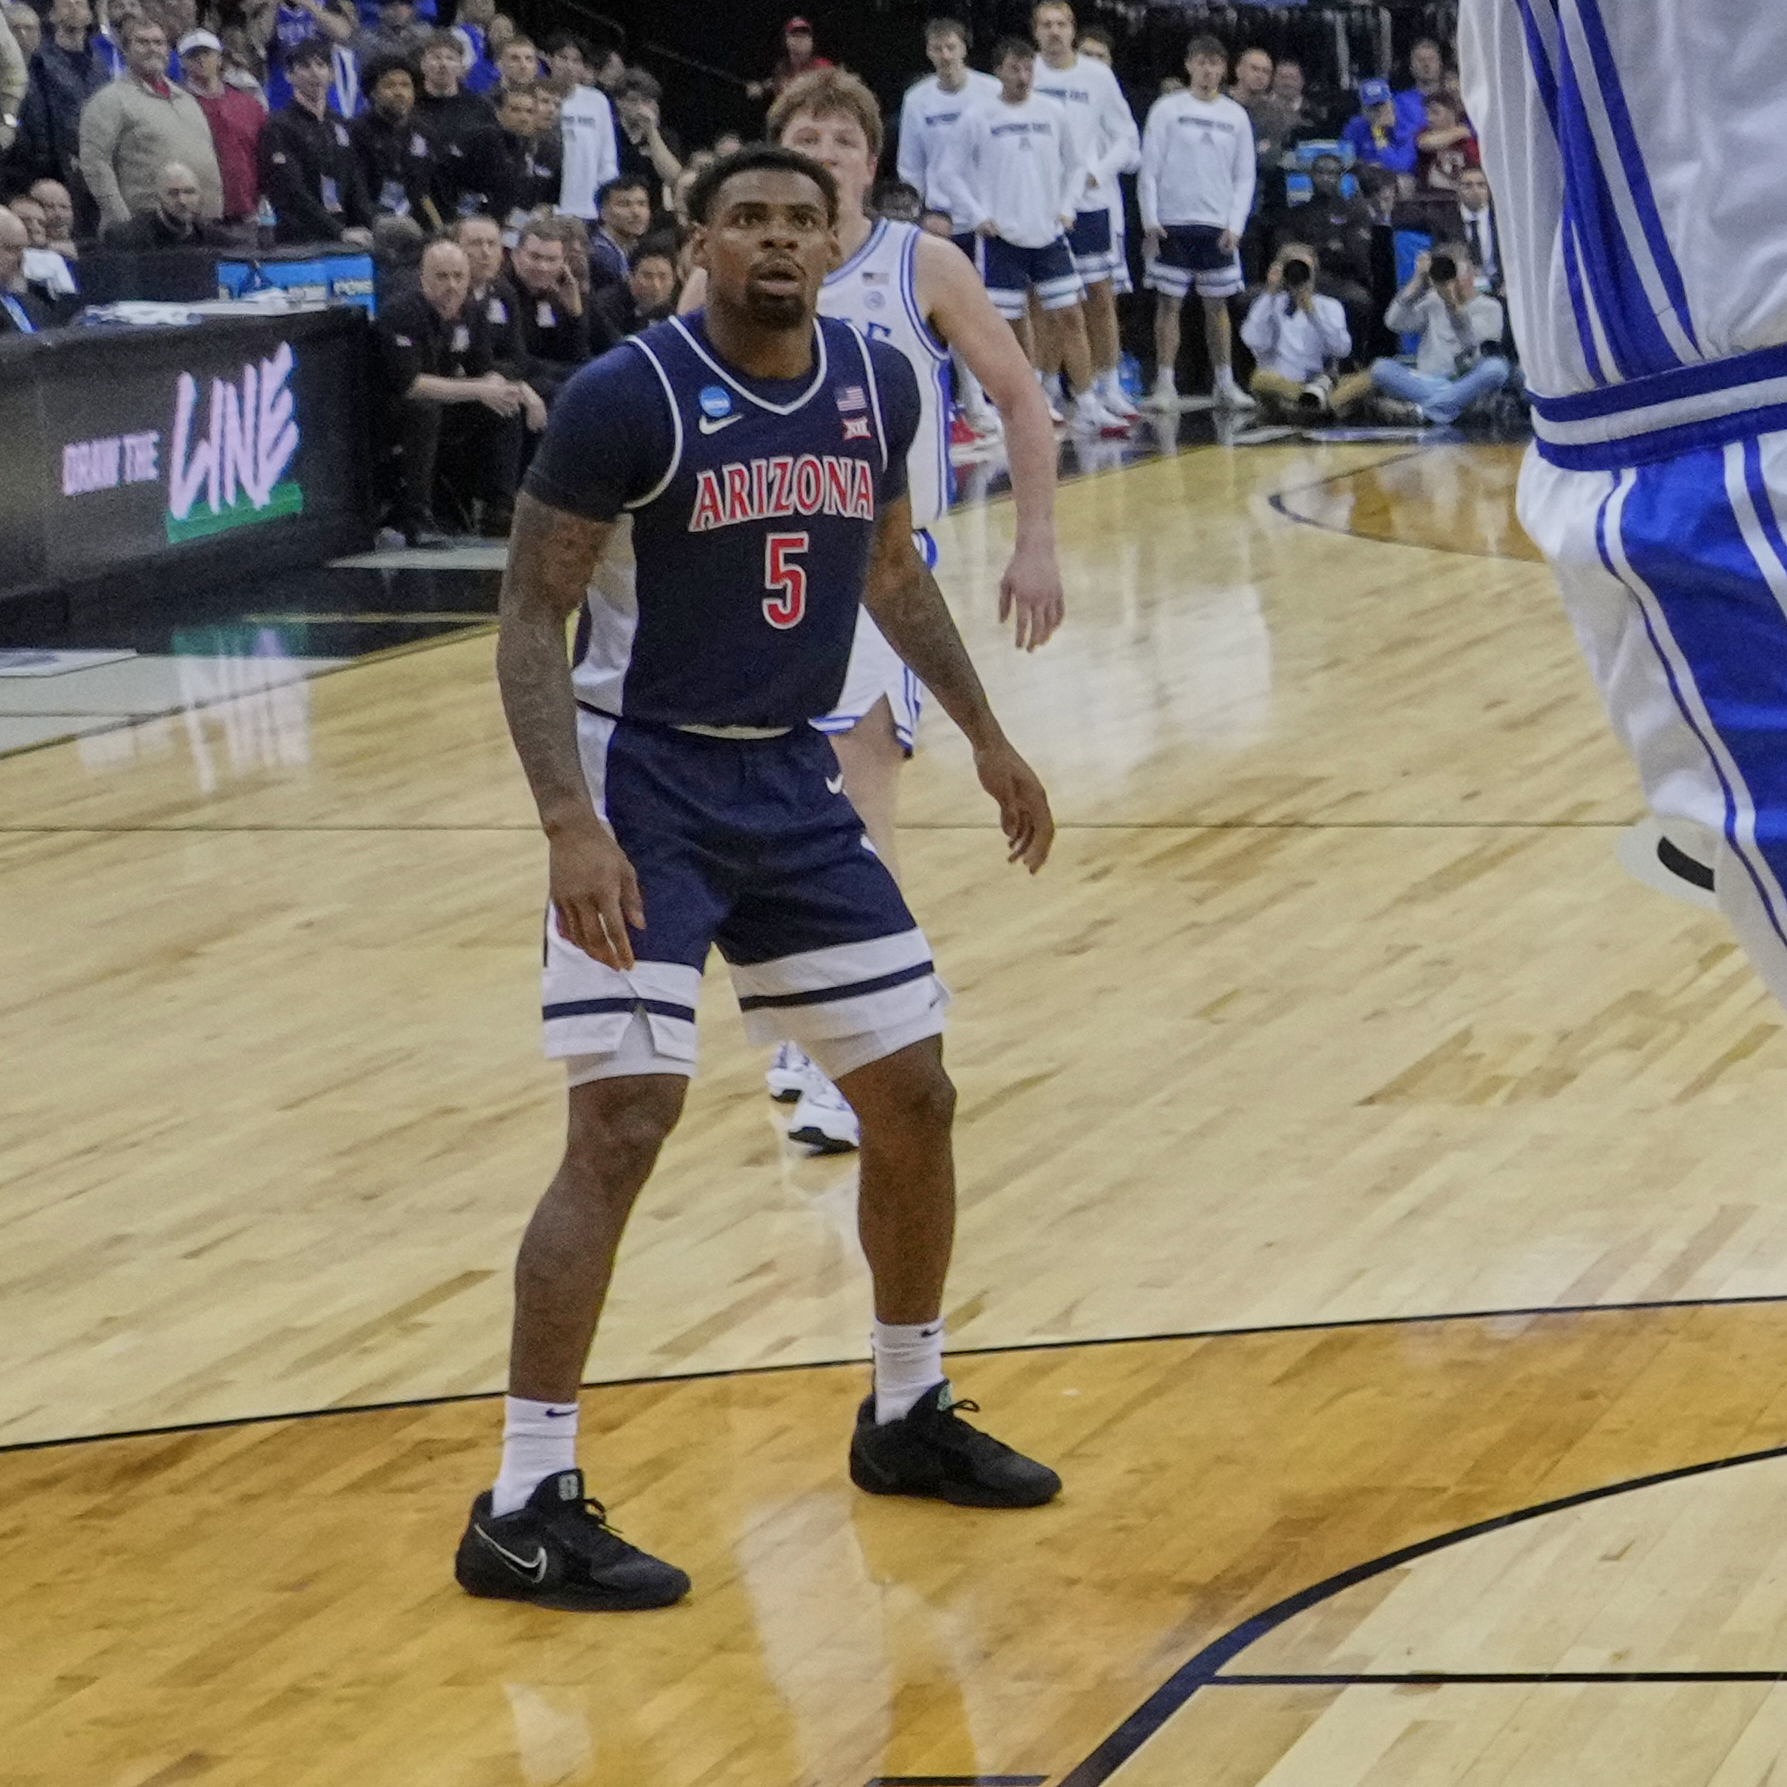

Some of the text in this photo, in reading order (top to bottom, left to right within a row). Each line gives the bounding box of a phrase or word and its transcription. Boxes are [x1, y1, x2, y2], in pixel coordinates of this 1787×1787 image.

[168, 340, 300, 521] LINE
[688, 453, 874, 533] ARIZONA
[762, 530, 809, 630] 5
